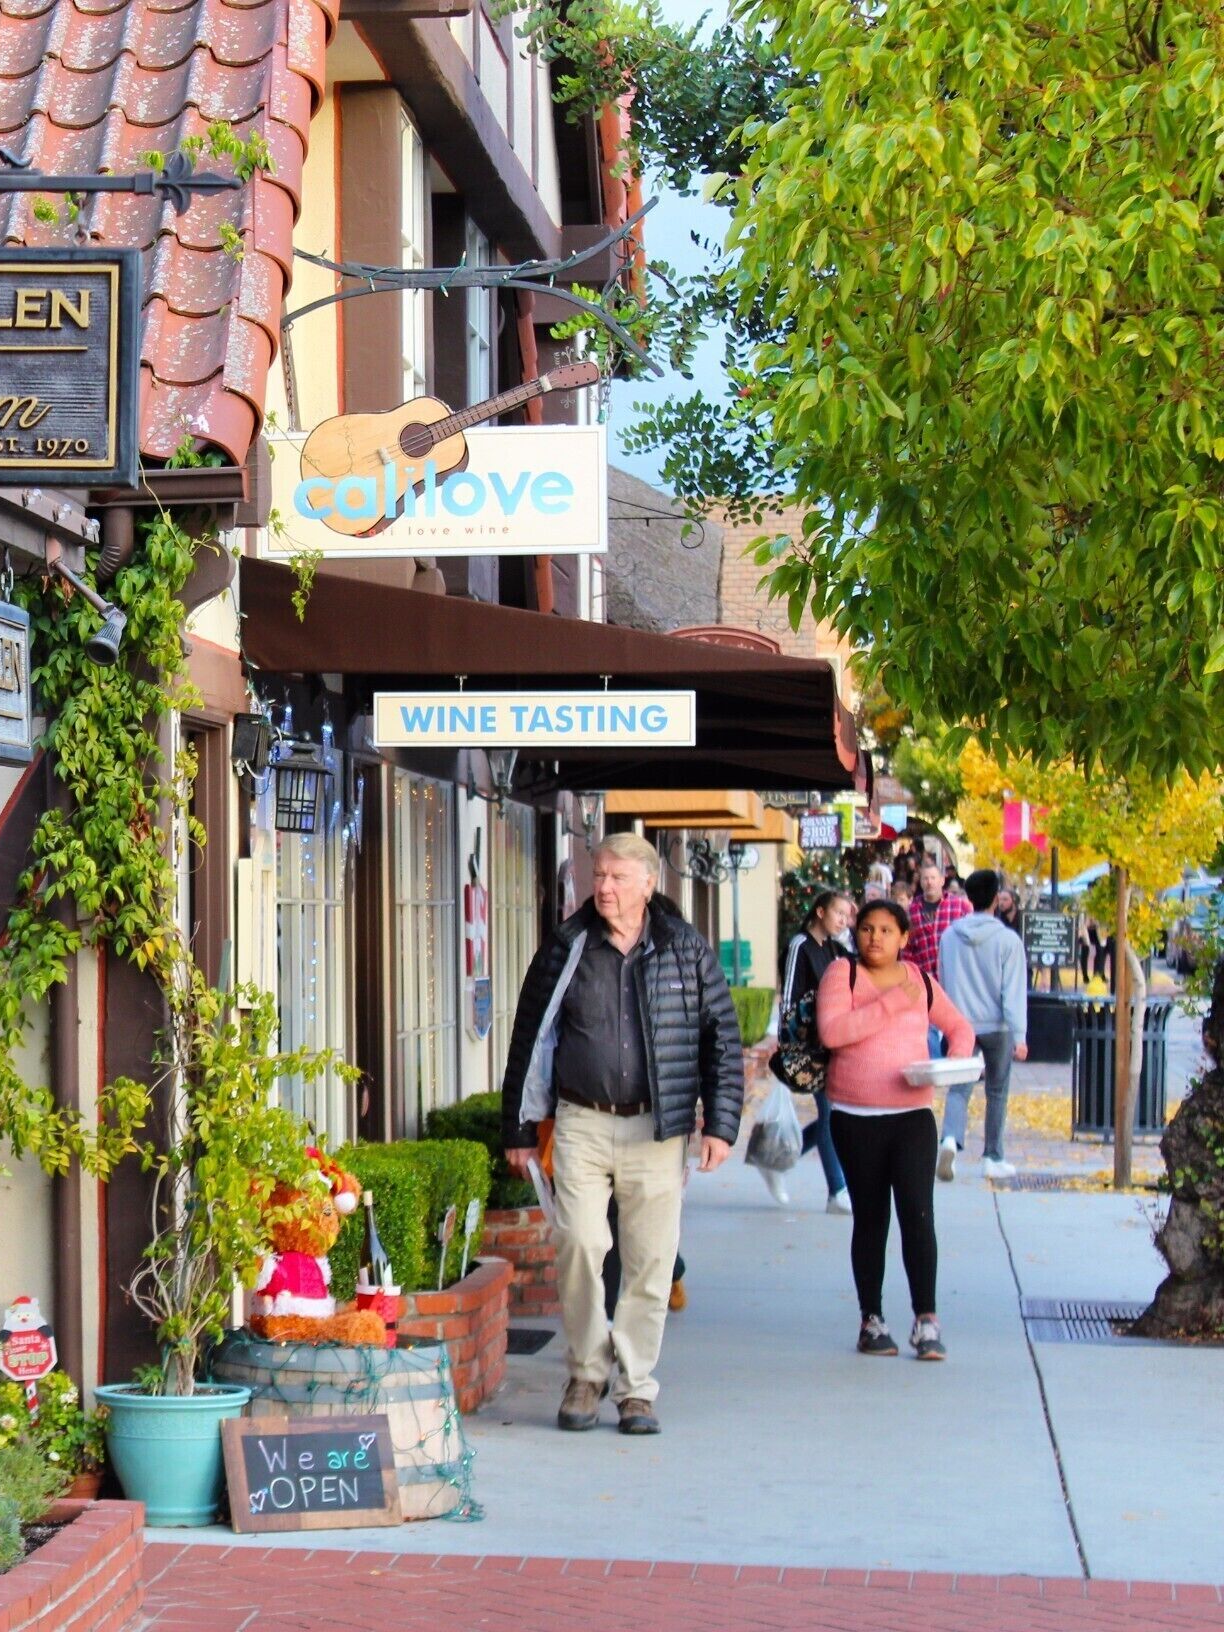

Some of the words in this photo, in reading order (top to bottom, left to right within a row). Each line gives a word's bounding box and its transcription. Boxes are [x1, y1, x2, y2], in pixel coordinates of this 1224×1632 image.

[35, 437, 89, 457] 1970
[293, 459, 574, 520] calilove
[408, 525, 450, 536] love
[465, 524, 510, 535] wine
[400, 705, 497, 733] WINE
[509, 705, 669, 733] TASTING
[801, 826, 836, 837] SHOE
[801, 837, 837, 848] STORE
[11, 1335, 41, 1346] Santa
[7, 1351, 49, 1368] STOP
[258, 1439, 316, 1474] We
[327, 1449, 371, 1471] are
[269, 1475, 360, 1509] OPEN
